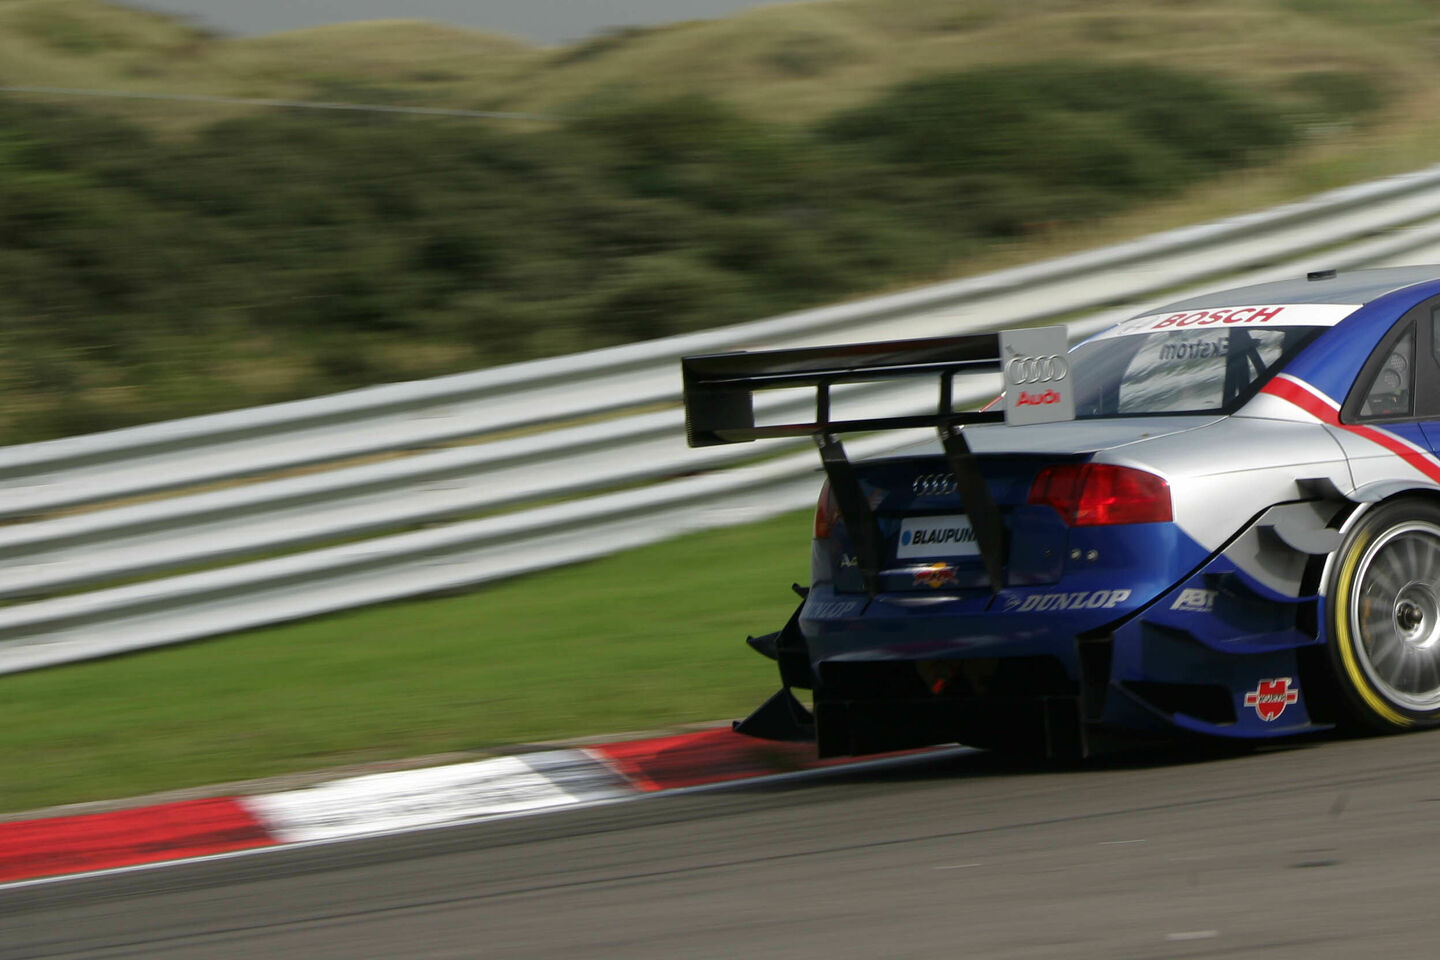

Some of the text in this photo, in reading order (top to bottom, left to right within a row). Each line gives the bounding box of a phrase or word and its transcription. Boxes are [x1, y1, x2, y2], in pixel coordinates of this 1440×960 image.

[1151, 306, 1286, 330] BOSCH
[1015, 388, 1062, 408] Audi
[911, 527, 979, 546] BLAUPUN
[1015, 589, 1132, 613] DUNLOP
